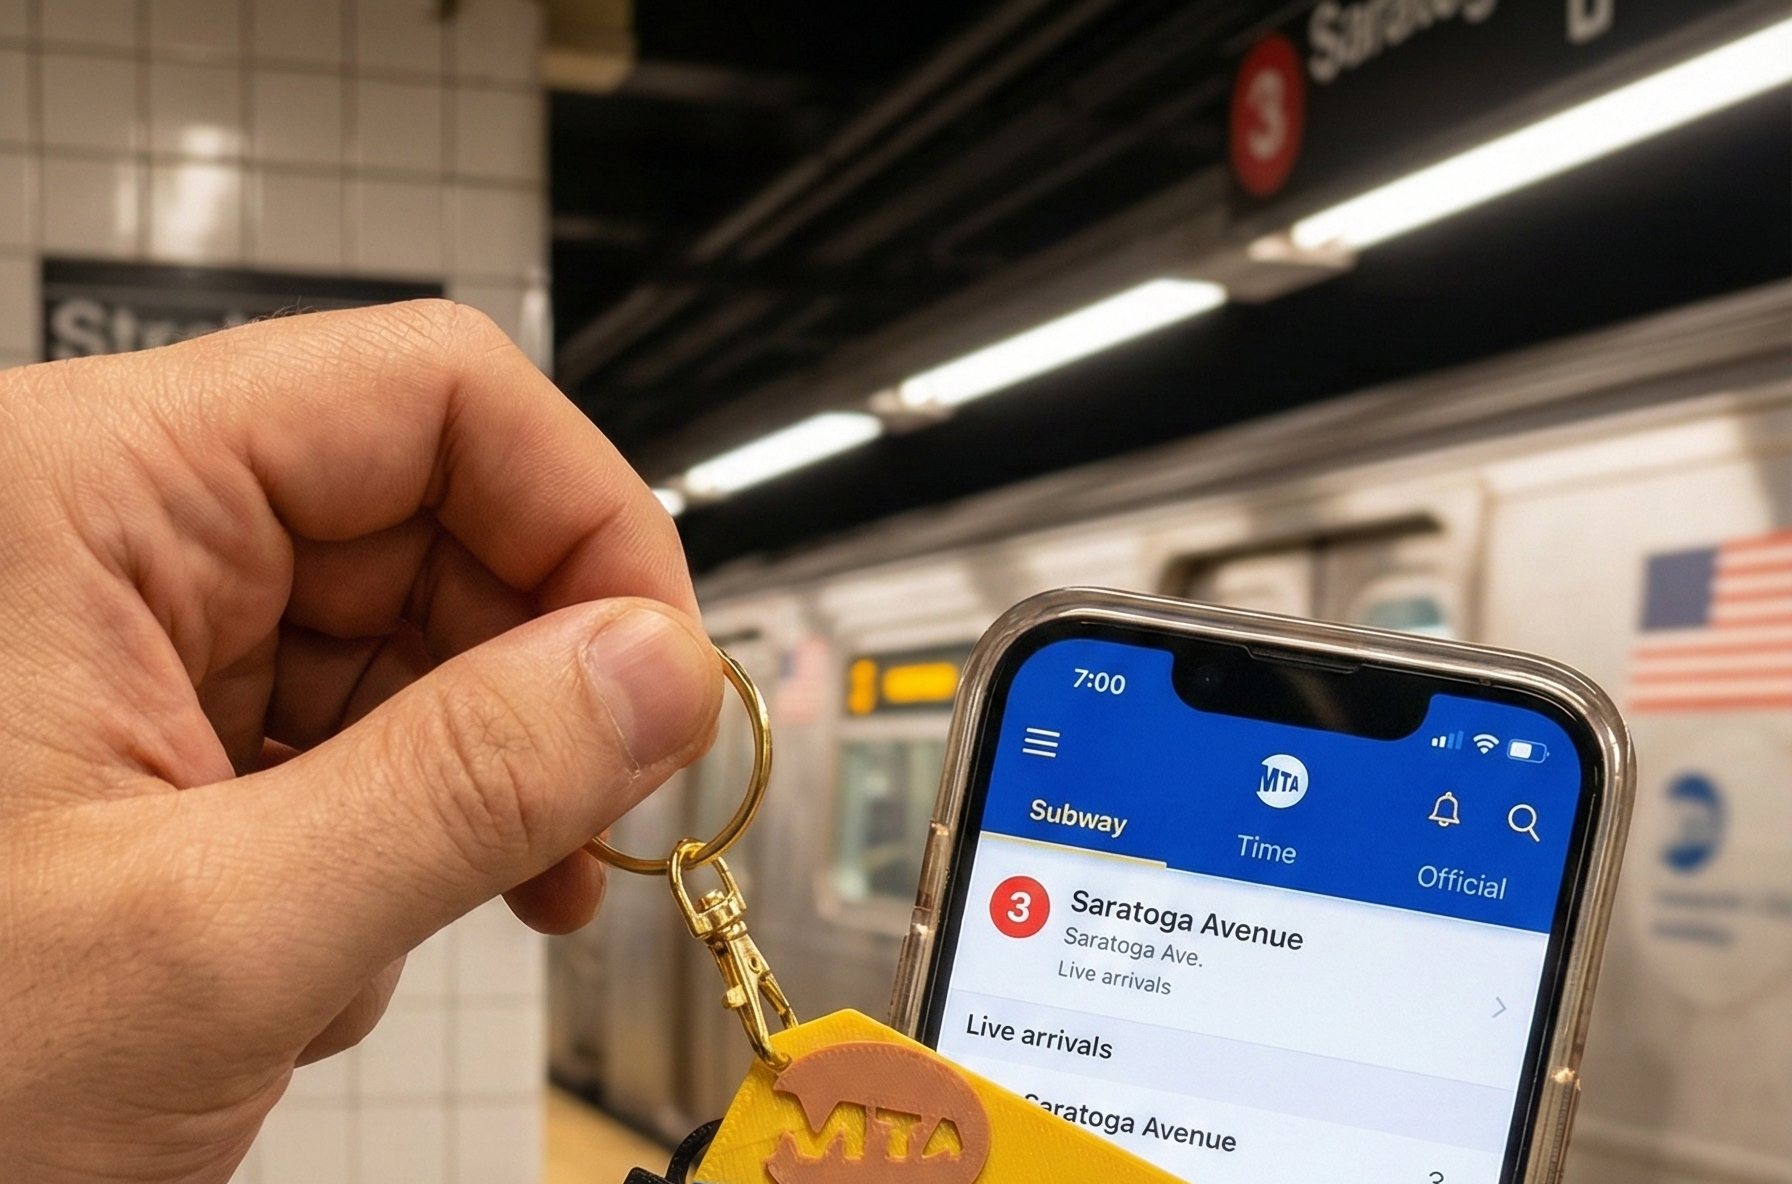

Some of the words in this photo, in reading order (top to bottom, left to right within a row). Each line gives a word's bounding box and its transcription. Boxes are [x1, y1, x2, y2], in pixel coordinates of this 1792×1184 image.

[1247, 68, 1288, 162] 3
[1073, 668, 1126, 695] 7:00
[1258, 760, 1300, 797] MTA
[1028, 799, 1128, 840] Subway
[1237, 834, 1297, 864] Time
[1417, 865, 1507, 900] Official
[1007, 891, 1032, 923] 3
[1070, 889, 1194, 933] Saratoga
[1199, 912, 1304, 951] Avenue
[1063, 926, 1157, 961] Saratoga
[1160, 943, 1203, 968] Ave.
[1057, 959, 1097, 982] Live
[1101, 967, 1173, 996] arrivals
[966, 1013, 1015, 1042] Live
[1021, 1028, 1113, 1060] arrivals
[776, 1100, 964, 1162] MTA
[1141, 1116, 1237, 1153] Avenue
